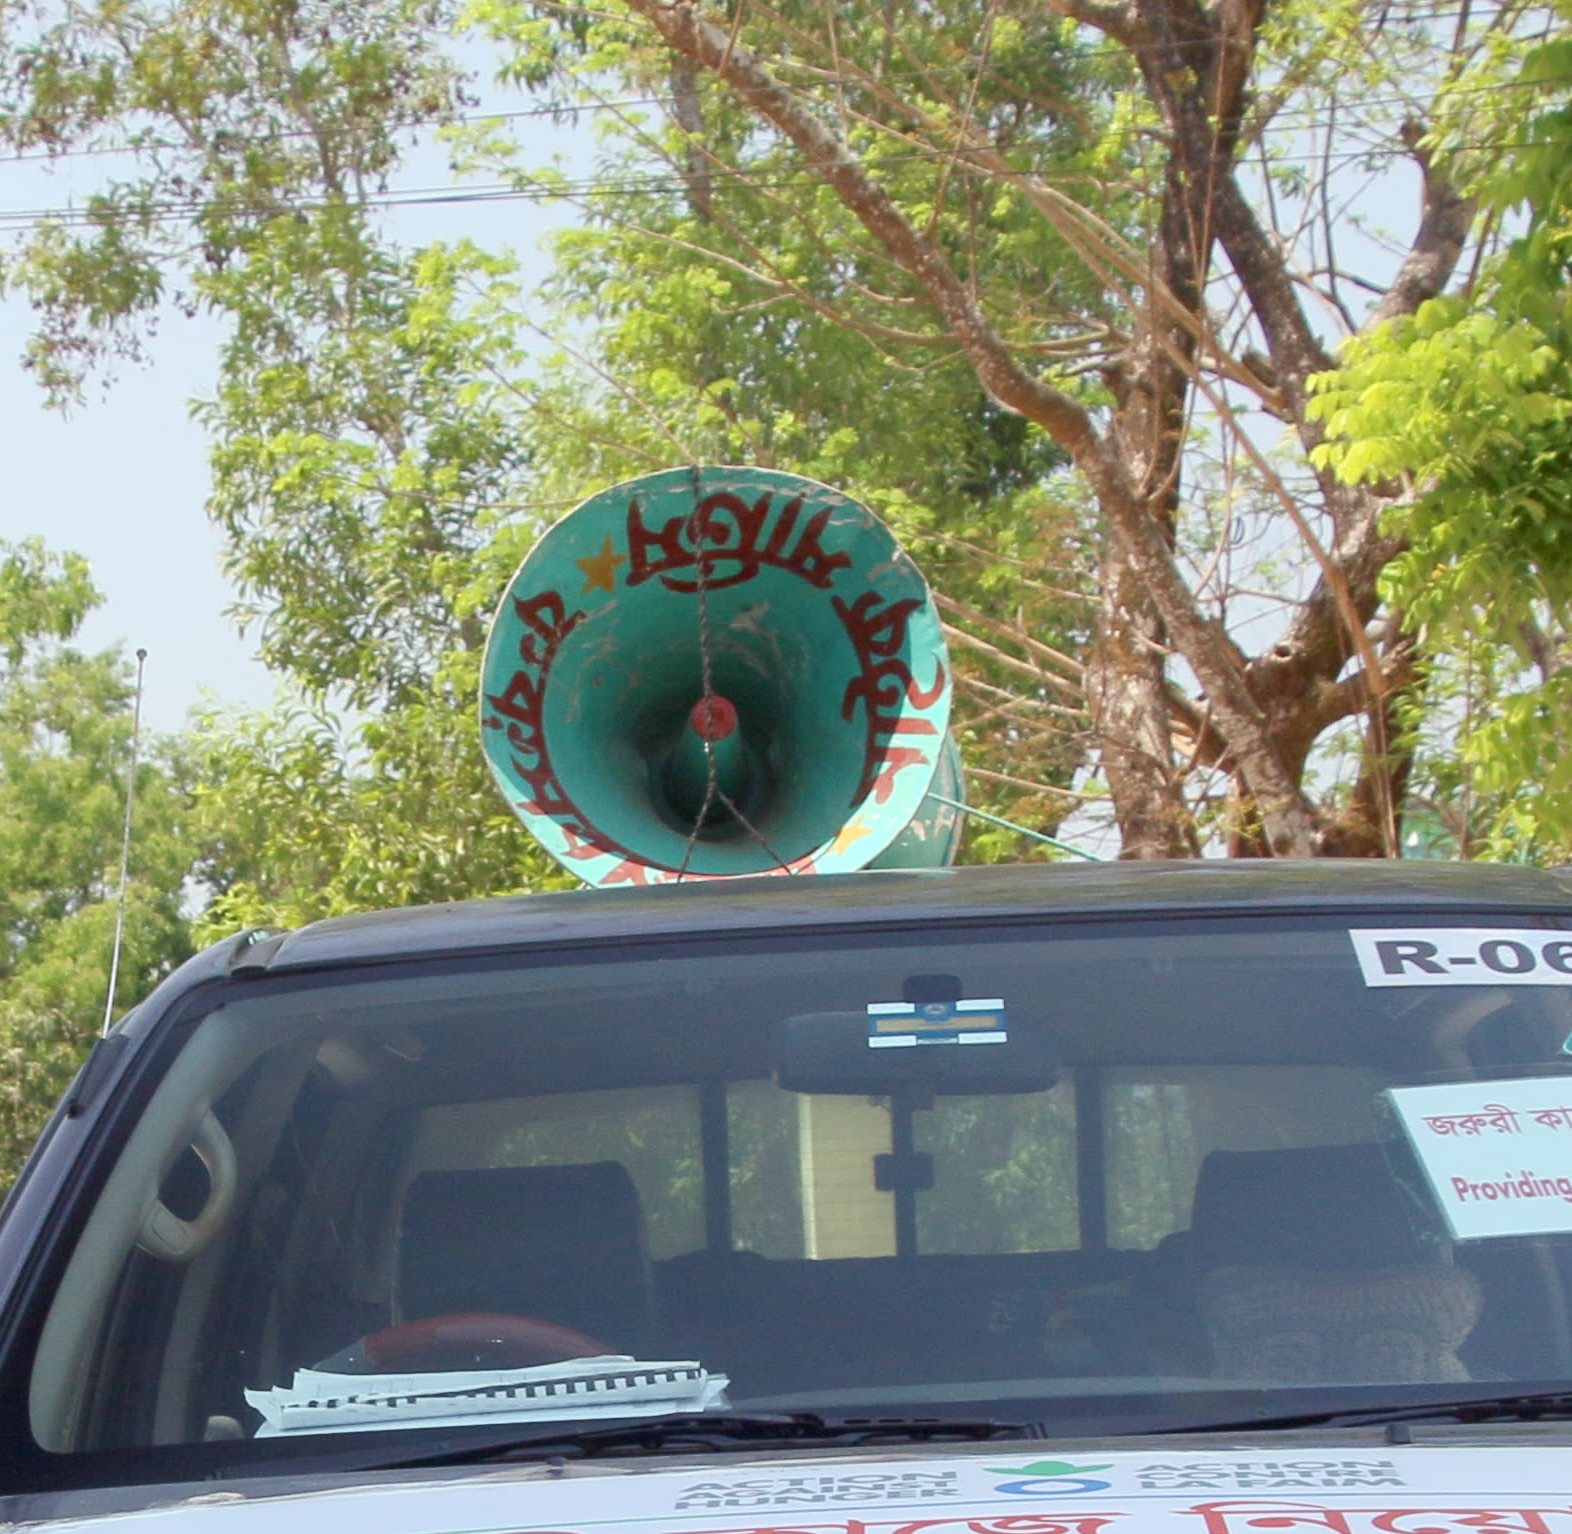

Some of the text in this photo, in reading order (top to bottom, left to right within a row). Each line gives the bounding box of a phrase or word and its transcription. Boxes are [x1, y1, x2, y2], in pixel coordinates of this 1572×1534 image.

[1421, 1104, 1522, 1137] জরুরী
[1135, 1460, 1397, 1473] ACTION
[1136, 1469, 1400, 1480] CONTRE
[678, 1481, 952, 1501] AGAINST
[681, 1471, 957, 1492] ACTION
[1141, 1477, 1408, 1490] LA FAIM
[674, 1488, 962, 1510] HUNGER
